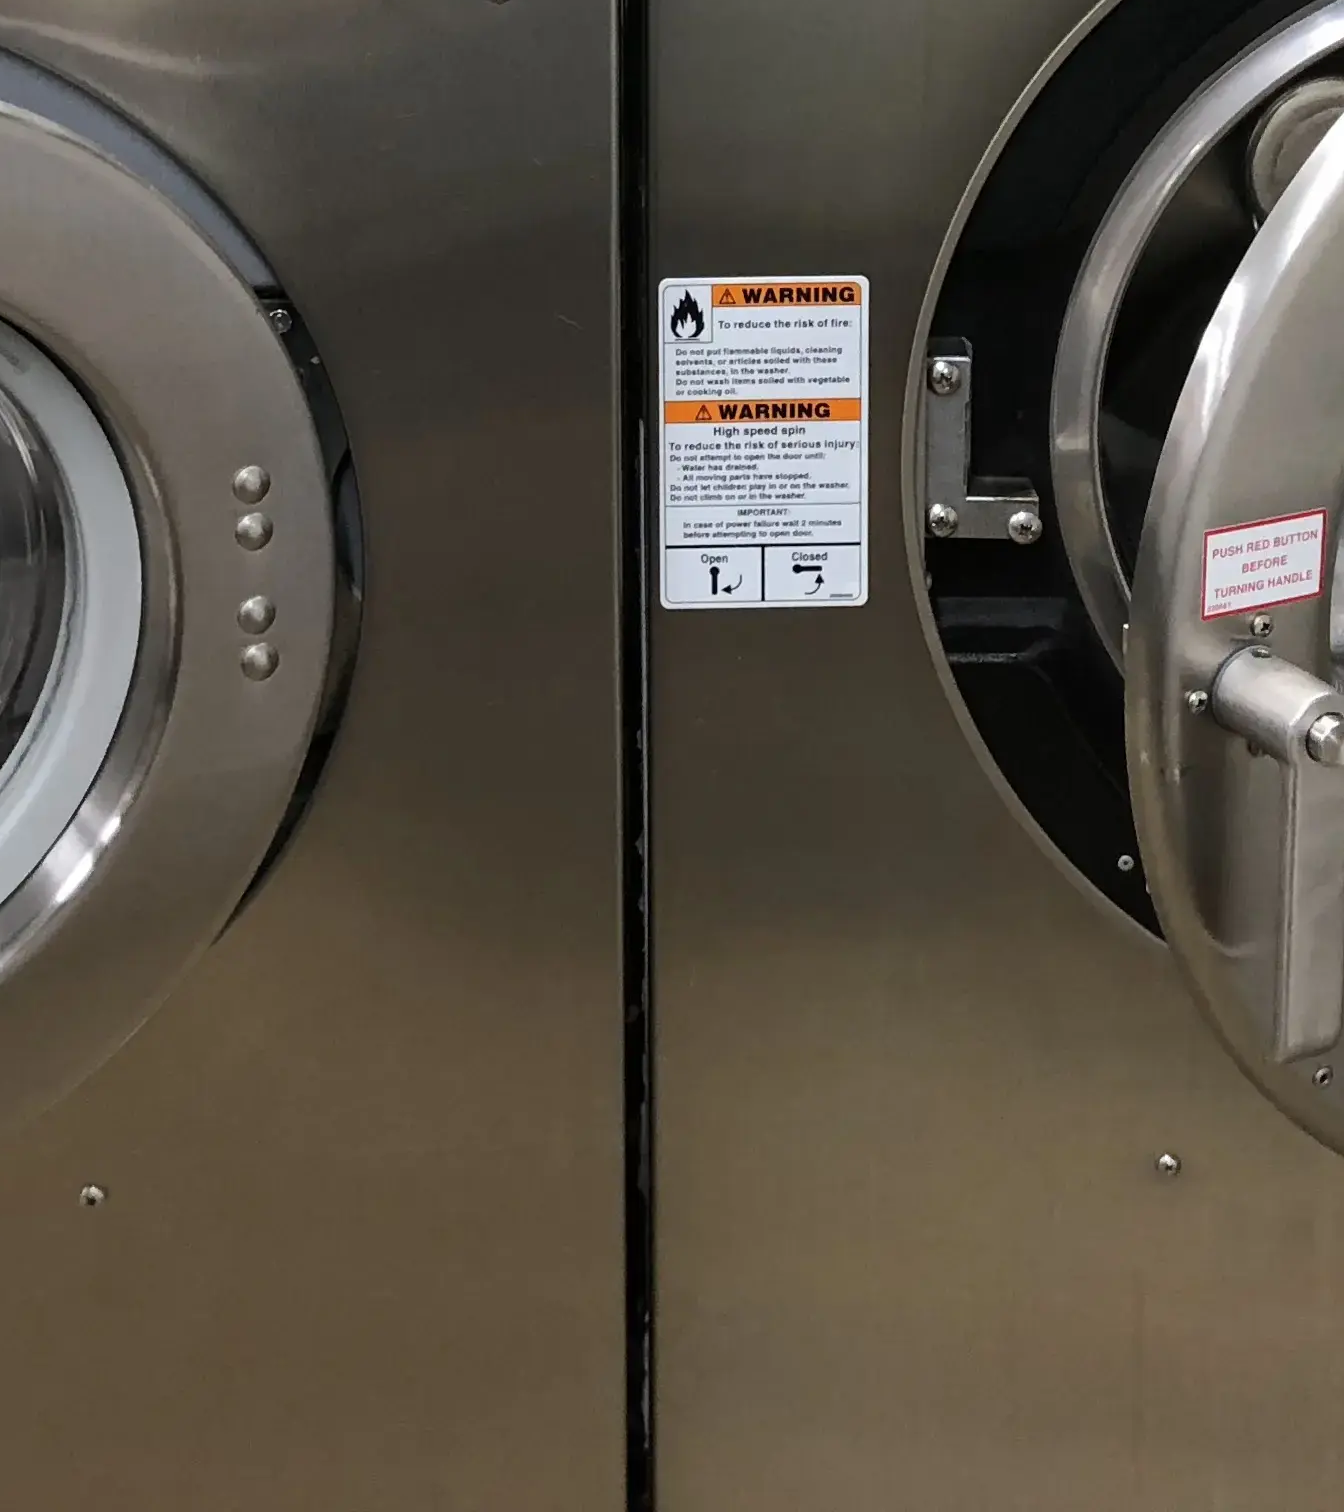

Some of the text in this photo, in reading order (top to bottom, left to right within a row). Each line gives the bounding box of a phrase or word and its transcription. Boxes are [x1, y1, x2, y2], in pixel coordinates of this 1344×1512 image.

[741, 287, 855, 304] WARNING
[718, 318, 853, 329] To reduce the risk of fire:
[676, 348, 687, 356] Do
[690, 348, 704, 356] not
[707, 348, 721, 357] put
[723, 347, 768, 355] flammable
[805, 346, 843, 355] cleaning
[676, 378, 687, 386] Do
[690, 378, 704, 386] not
[732, 377, 755, 385] items
[808, 376, 850, 385] vegetable
[687, 388, 722, 396] cooking
[718, 403, 831, 420] WARNING
[713, 426, 806, 438] High speed spin
[669, 442, 681, 451] To
[684, 442, 721, 450] reduce
[724, 441, 741, 450] the
[744, 441, 764, 449] risk
[768, 440, 778, 449] of
[781, 440, 821, 448] serious
[670, 454, 681, 462] Do
[700, 454, 731, 462] attempt
[696, 474, 726, 482] moving
[729, 474, 750, 482] parts
[753, 473, 773, 481] have
[726, 521, 751, 529] power
[683, 531, 710, 539] before
[712, 531, 756, 539] attempting
[770, 530, 790, 538] open
[1212, 529, 1319, 559] PUSH RED BUTTON
[700, 553, 728, 565] Open
[791, 551, 828, 561] Closed
[1241, 554, 1288, 574] BEFORE
[1214, 569, 1313, 599] TURNING HANDLE
